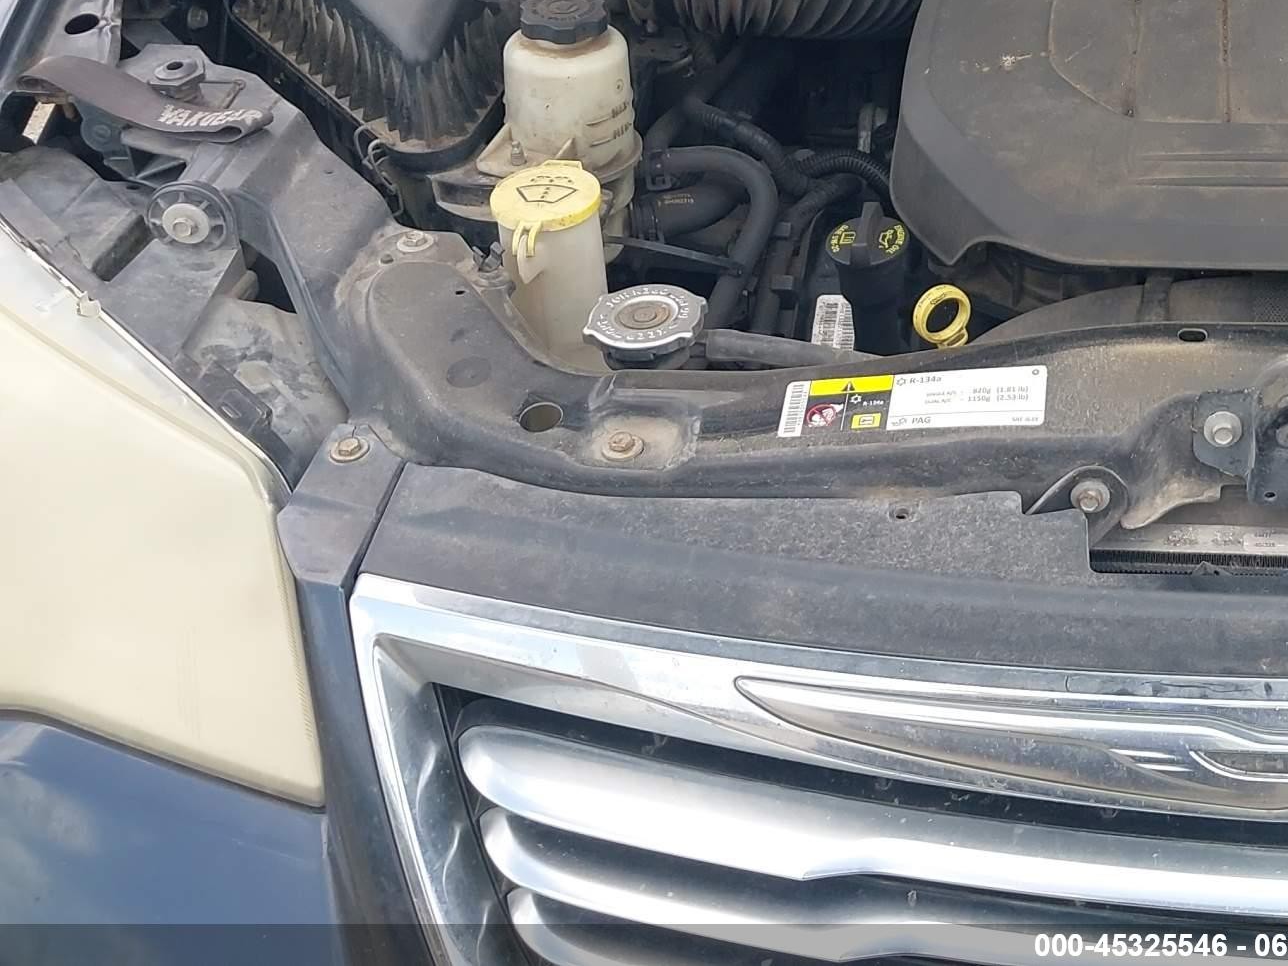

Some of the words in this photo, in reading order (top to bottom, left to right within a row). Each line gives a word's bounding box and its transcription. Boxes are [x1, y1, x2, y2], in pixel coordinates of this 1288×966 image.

[894, 224, 905, 245] ENGINE
[909, 376, 942, 385] R-134a
[911, 416, 932, 424] PAG
